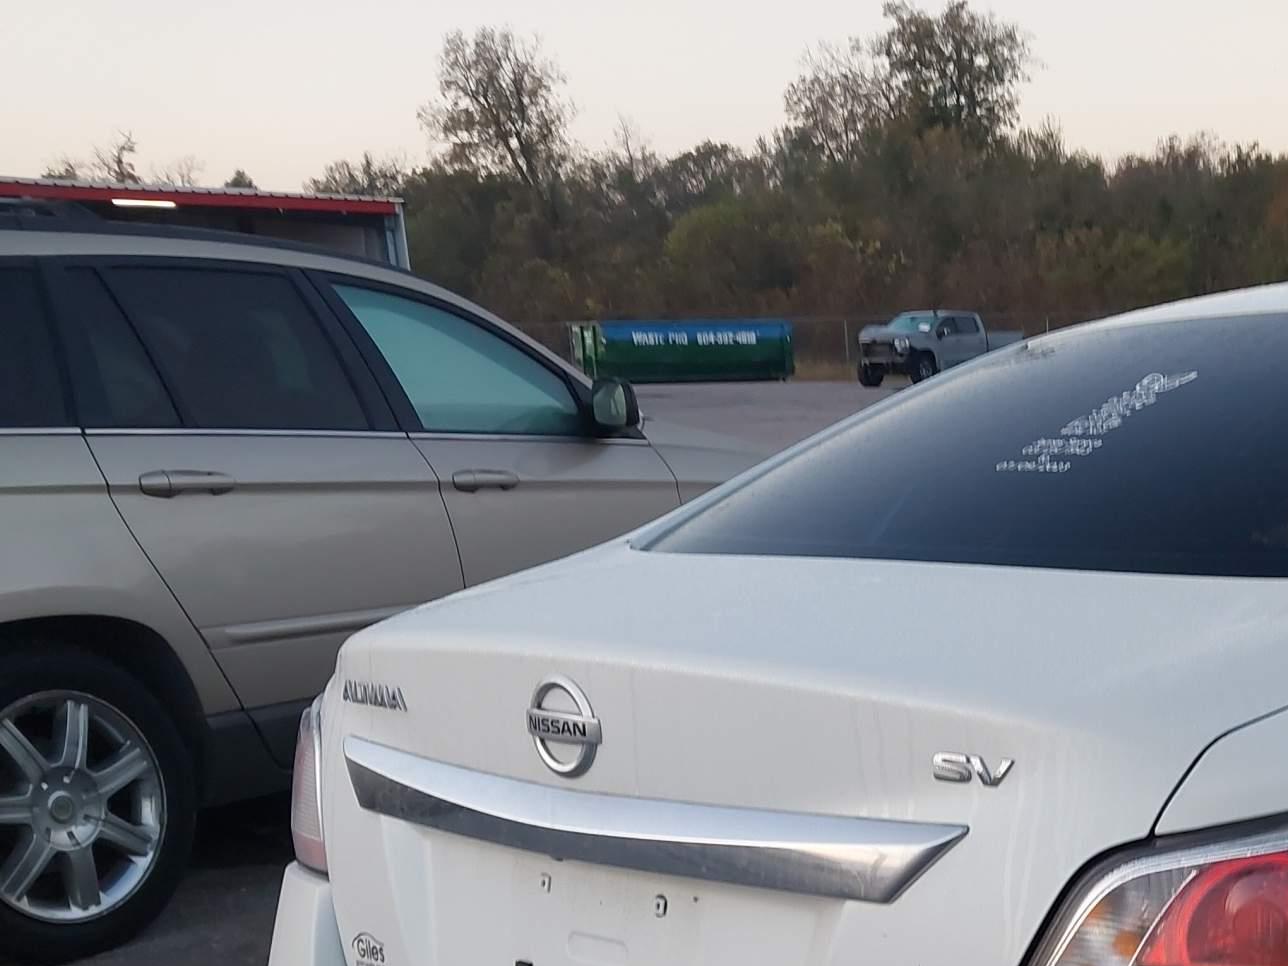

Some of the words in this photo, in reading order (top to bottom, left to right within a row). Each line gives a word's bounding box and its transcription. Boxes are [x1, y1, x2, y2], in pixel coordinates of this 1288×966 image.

[528, 714, 587, 737] NISSAN
[932, 752, 1015, 787] SV
[356, 938, 385, 963] Giles
